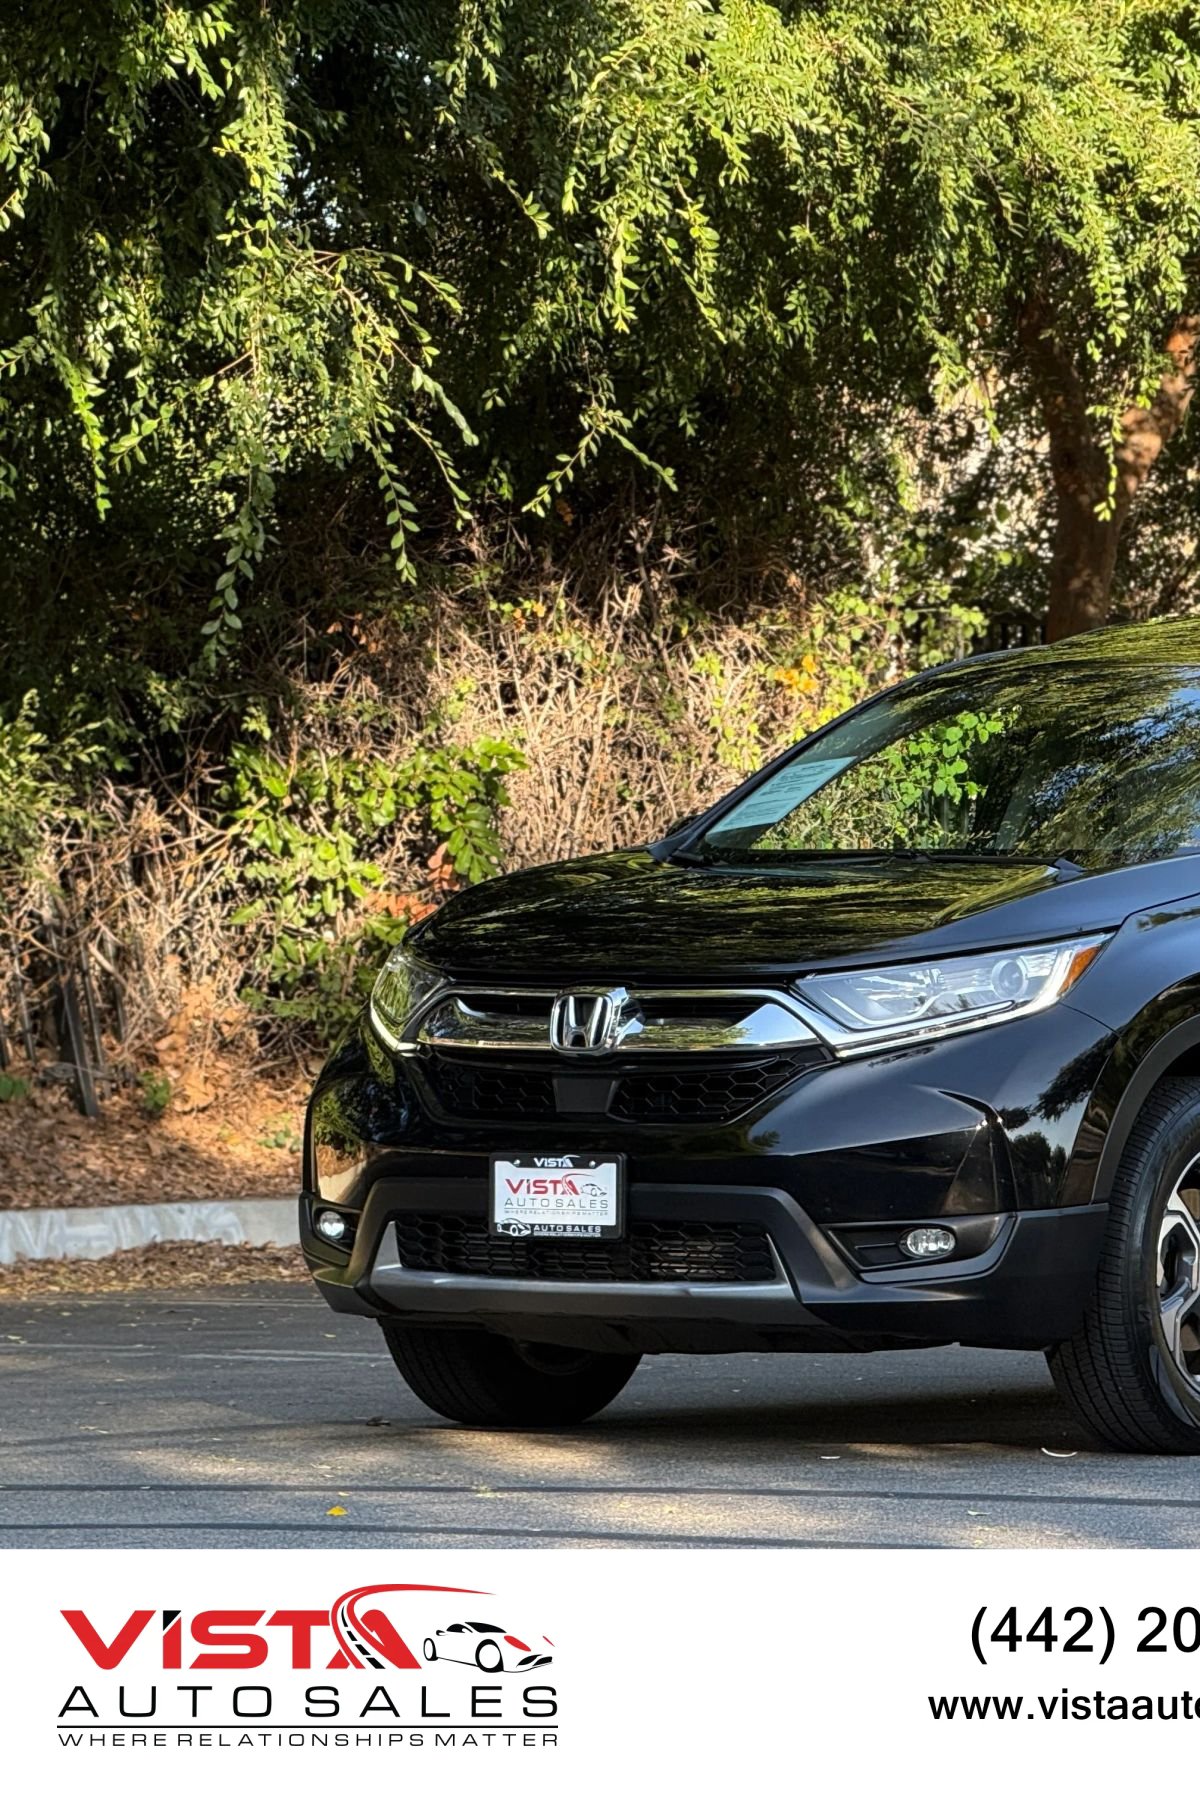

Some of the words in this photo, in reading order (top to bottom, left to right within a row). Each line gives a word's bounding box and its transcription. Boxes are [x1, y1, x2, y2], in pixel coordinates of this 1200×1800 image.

[533, 1156, 574, 1168] VISTA
[505, 1177, 580, 1195] VISTA
[504, 1198, 550, 1208] AUTO
[555, 1199, 609, 1209] SALES
[533, 1224, 563, 1232] AUTO
